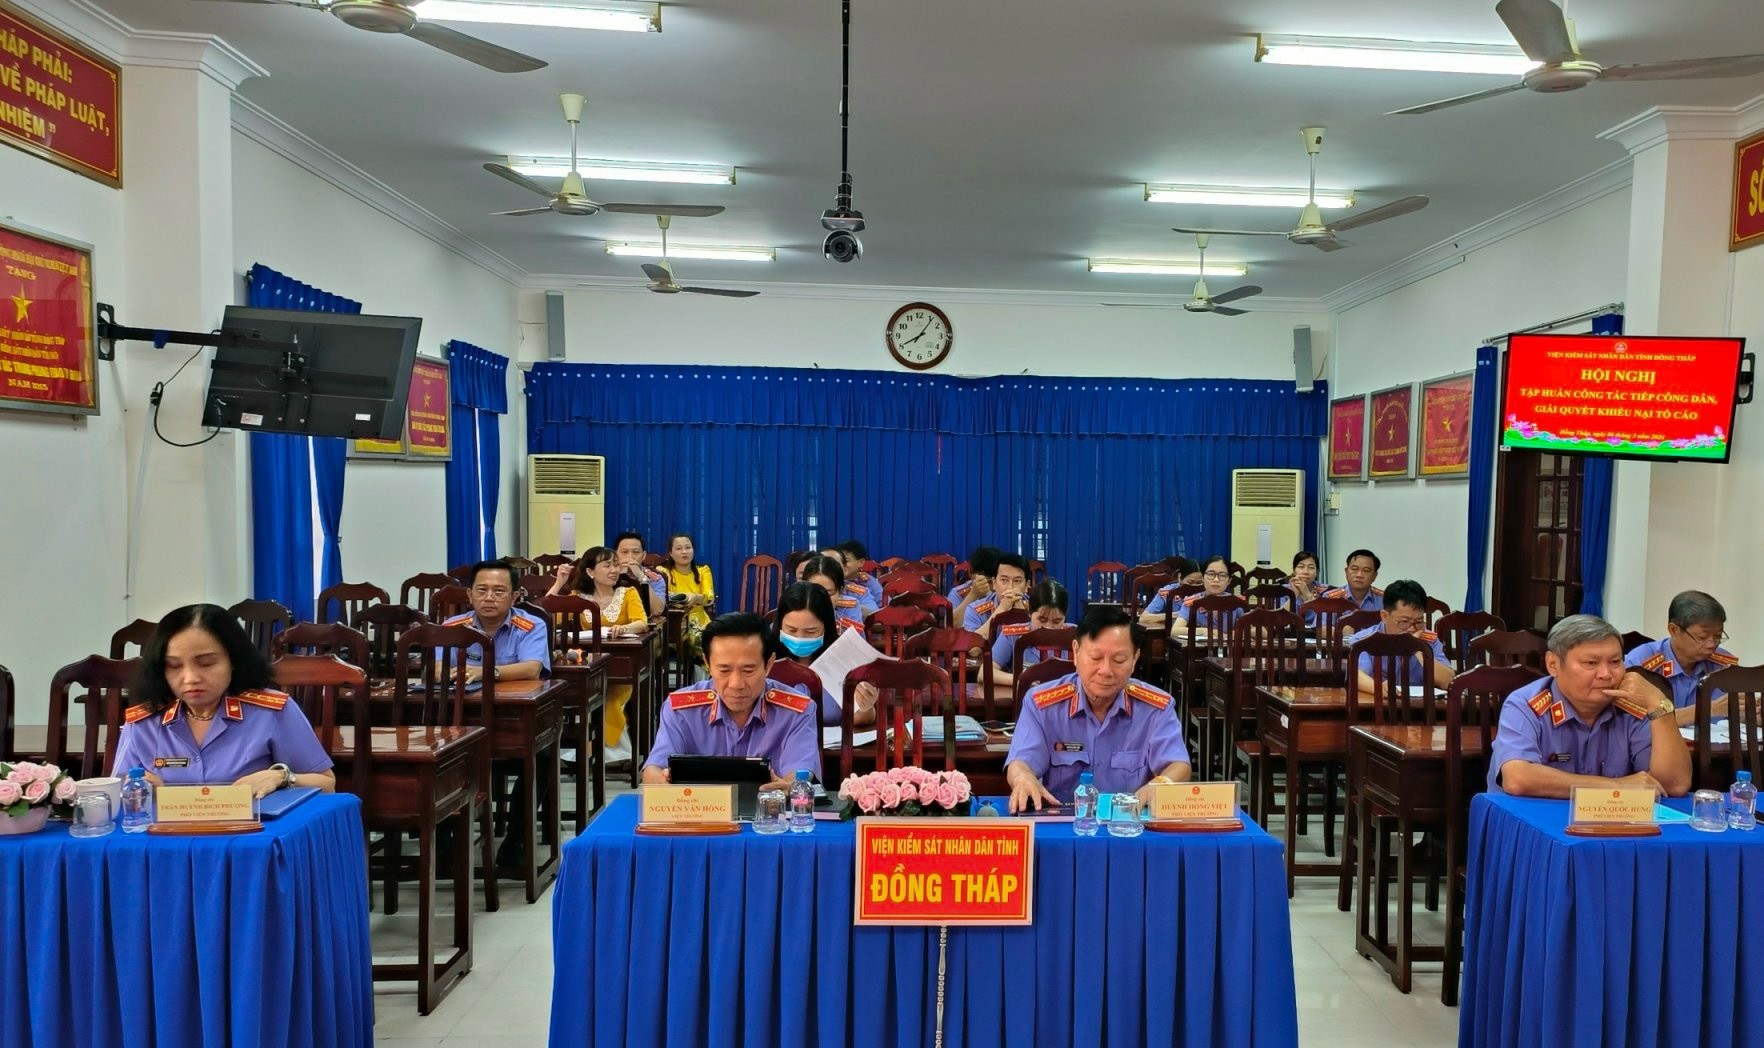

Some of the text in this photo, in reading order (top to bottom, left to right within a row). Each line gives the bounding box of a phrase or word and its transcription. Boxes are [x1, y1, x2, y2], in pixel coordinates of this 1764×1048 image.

[32, 45, 73, 84] PHẢI:
[0, 62, 110, 137] VỀ PHÁP LUẬT,
[1581, 368, 1656, 385] HỘI NGHỊ
[1520, 388, 1541, 398] TẬP
[1574, 389, 1604, 399] CÔNG
[1606, 390, 1627, 400] TÁC
[1656, 392, 1688, 403] CÔNG
[1692, 393, 1717, 404] DÂN,
[1634, 409, 1653, 419] NẠI
[1673, 410, 1697, 420] CÁO
[872, 832, 1018, 858] VIỆN KIỂM SÁT NHÂN DÂN TỈNH
[870, 863, 1018, 903] ĐỒNG THÁP
